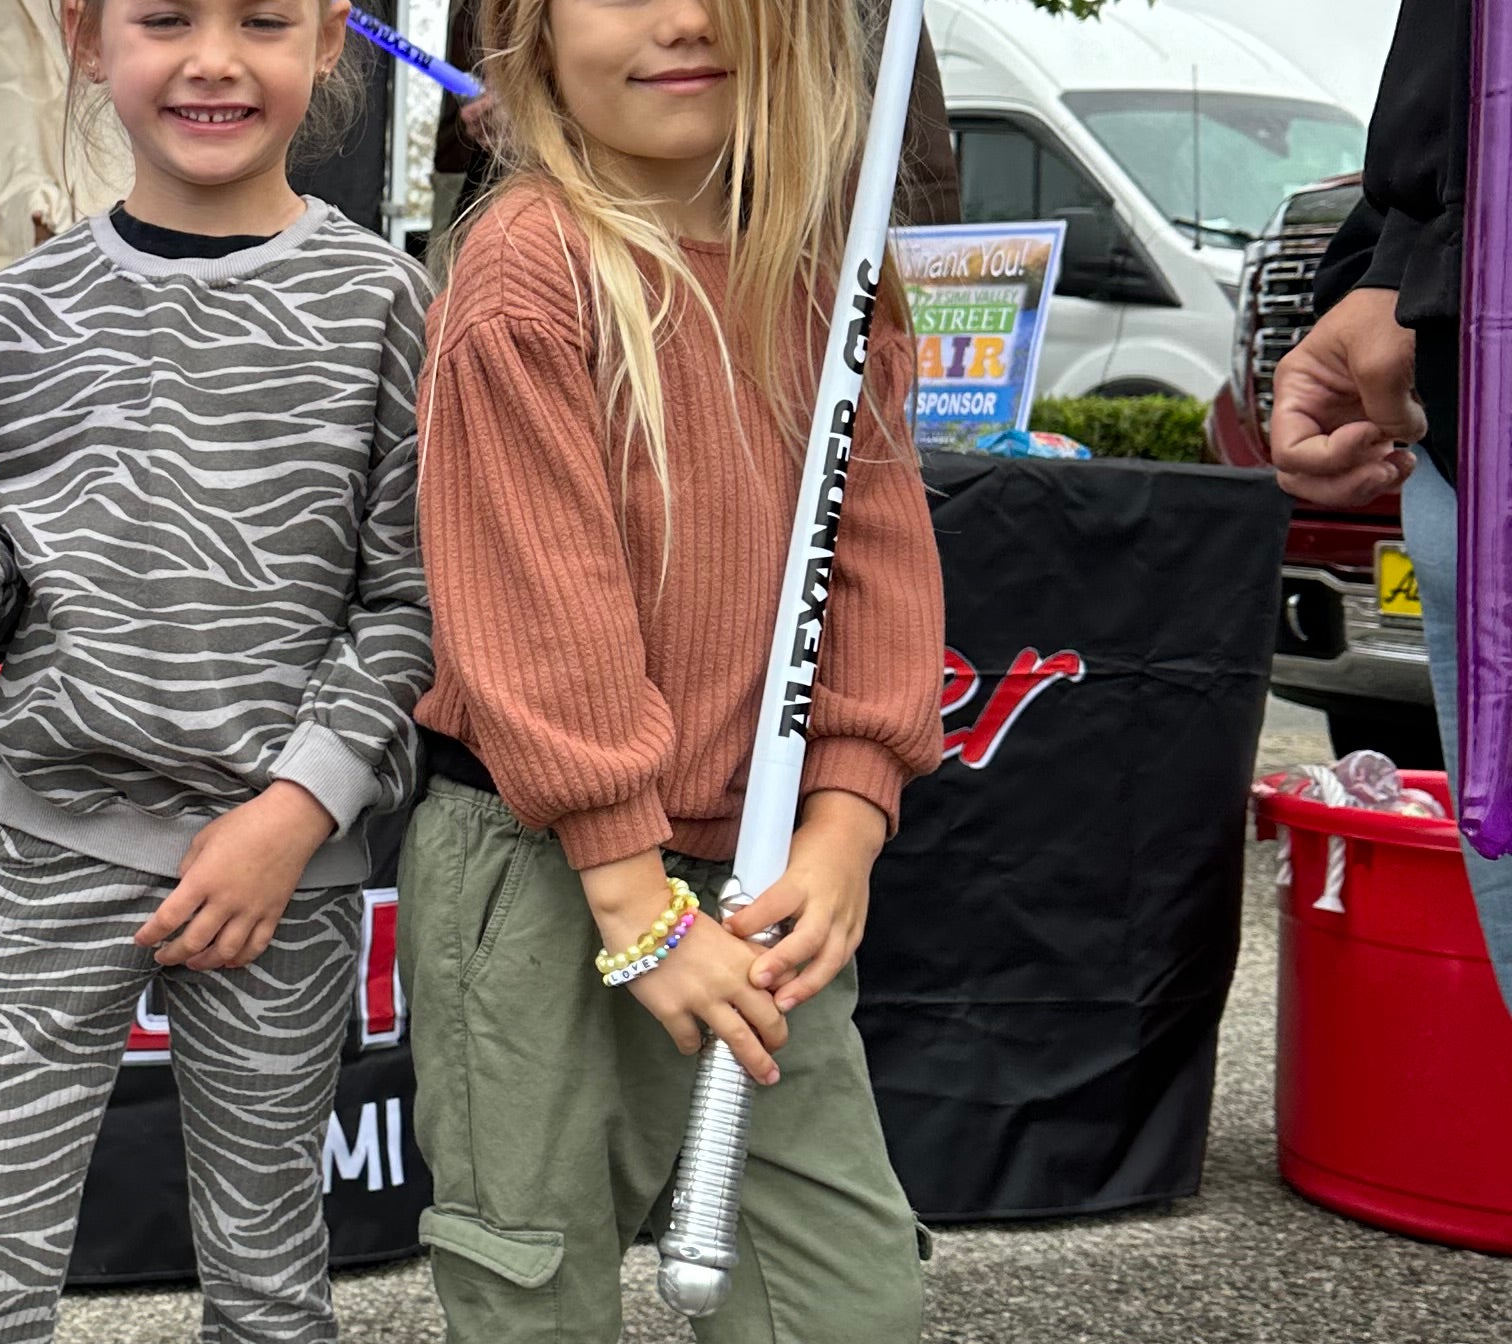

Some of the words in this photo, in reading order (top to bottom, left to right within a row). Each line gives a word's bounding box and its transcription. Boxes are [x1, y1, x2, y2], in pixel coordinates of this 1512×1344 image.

[979, 240, 1032, 278] You!
[921, 307, 1013, 332] STREET
[916, 336, 1006, 379] AIR
[916, 390, 998, 417] SPONSOR
[610, 958, 651, 982] LOVE
